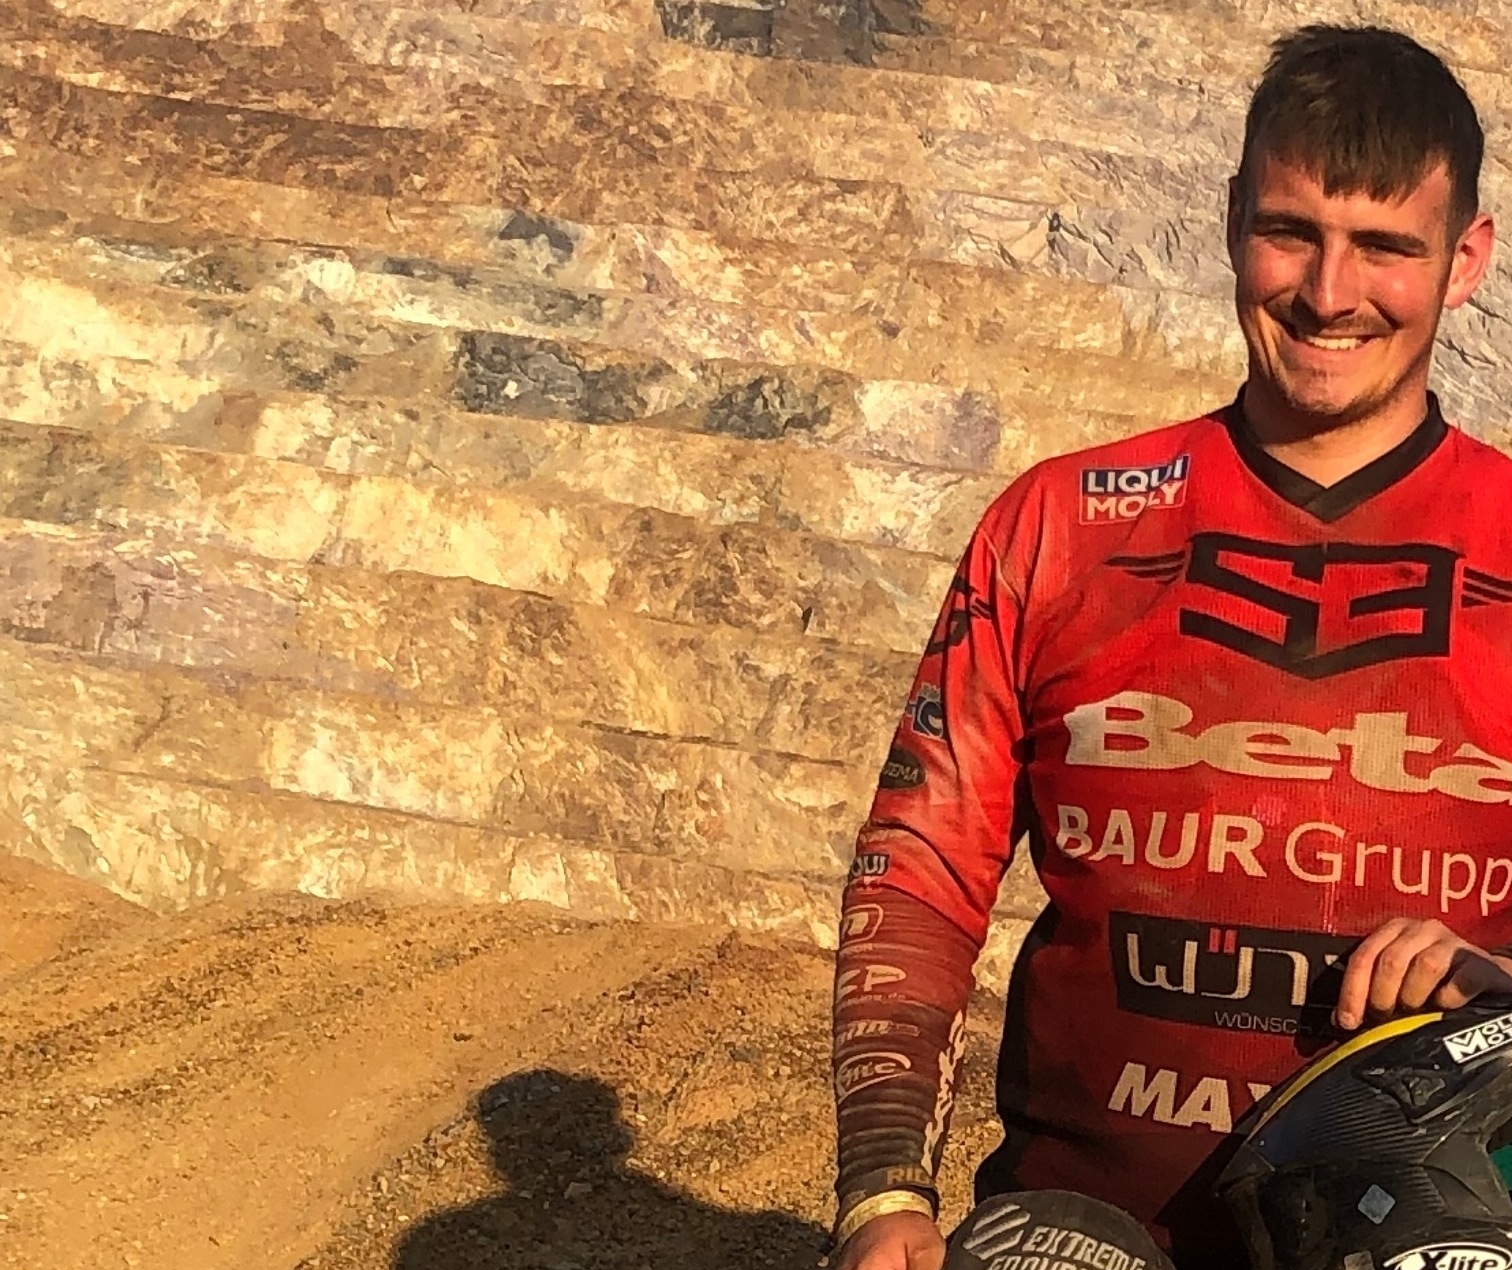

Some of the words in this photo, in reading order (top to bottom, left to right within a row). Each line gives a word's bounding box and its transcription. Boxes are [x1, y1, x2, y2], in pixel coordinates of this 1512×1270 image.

[1086, 481, 1184, 520] MOLY
[1087, 458, 1184, 493] LIQUI
[1179, 531, 1464, 678] S3
[1055, 804, 1269, 877] BAUR
